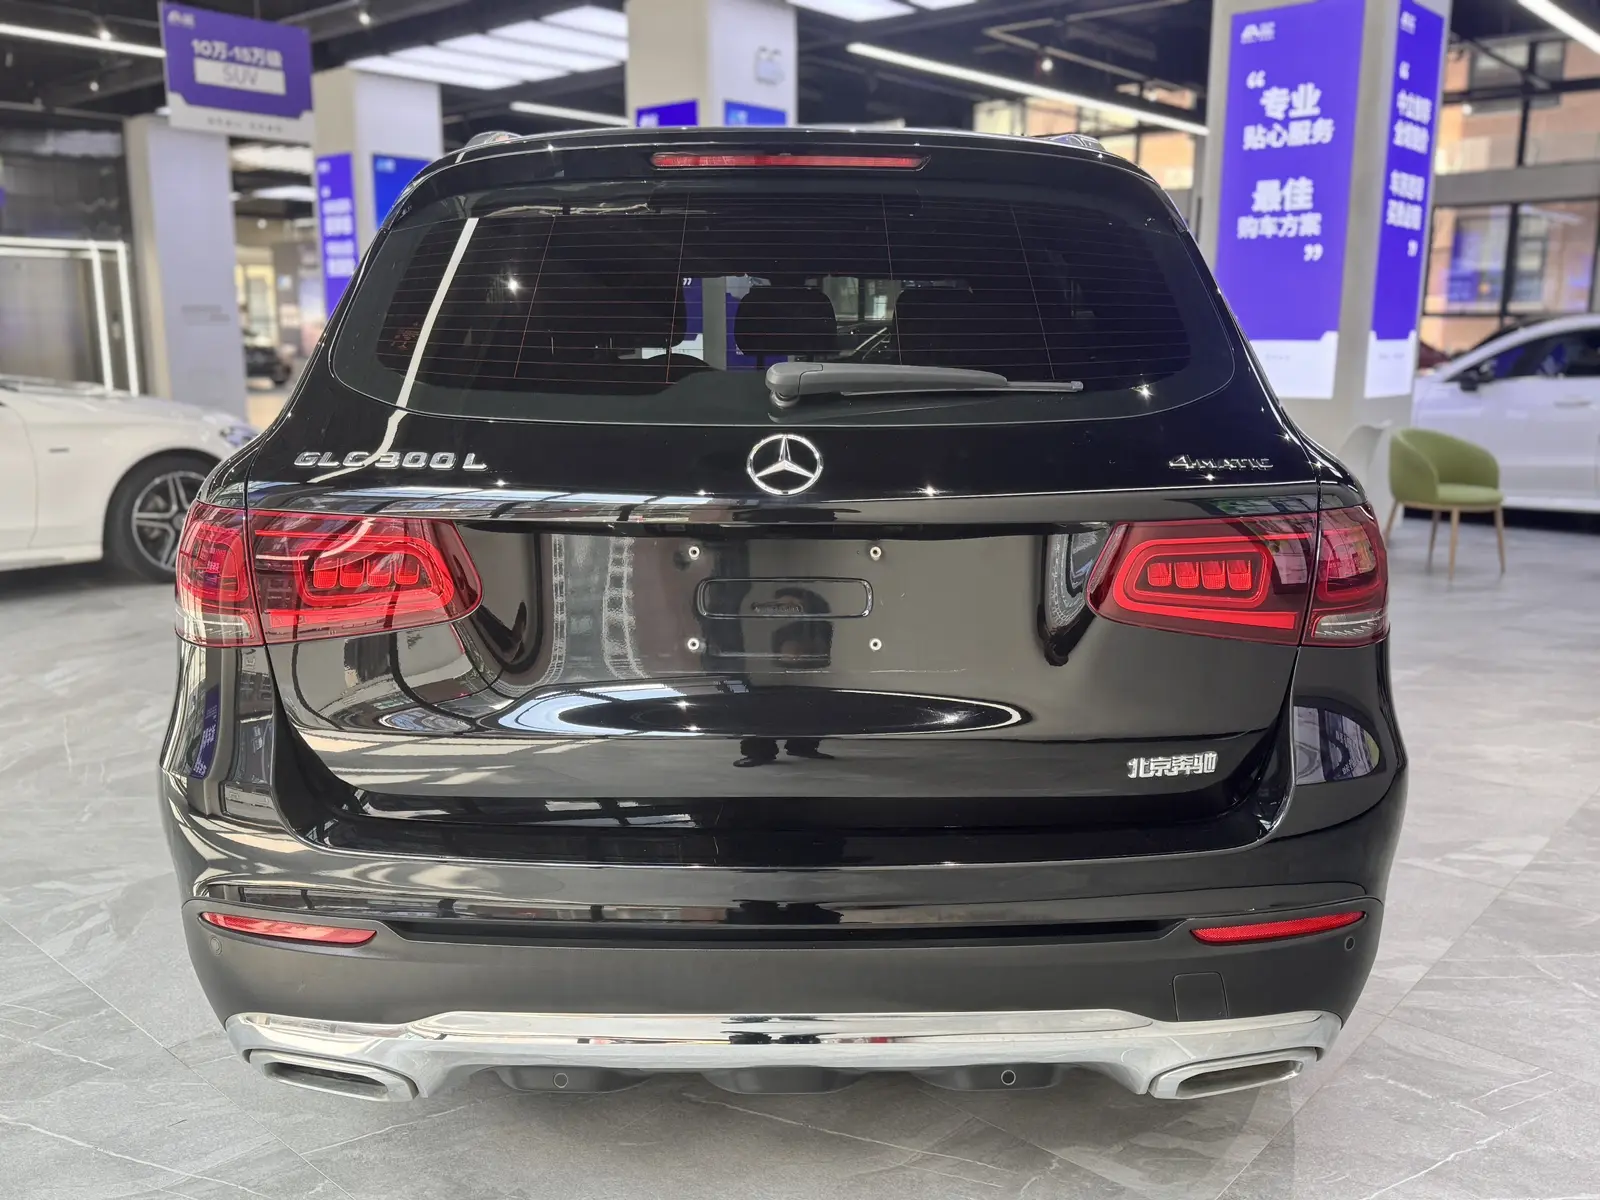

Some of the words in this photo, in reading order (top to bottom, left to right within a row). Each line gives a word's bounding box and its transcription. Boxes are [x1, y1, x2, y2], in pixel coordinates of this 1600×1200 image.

[222, 64, 260, 85] SUV
[1259, 82, 1322, 121] 专业
[1242, 117, 1336, 150] 贴心服务
[1251, 176, 1314, 213] 最佳
[294, 451, 371, 468] GLC
[374, 451, 458, 470] 300
[462, 452, 488, 470] L
[1127, 751, 1218, 779] 北京奔驰
